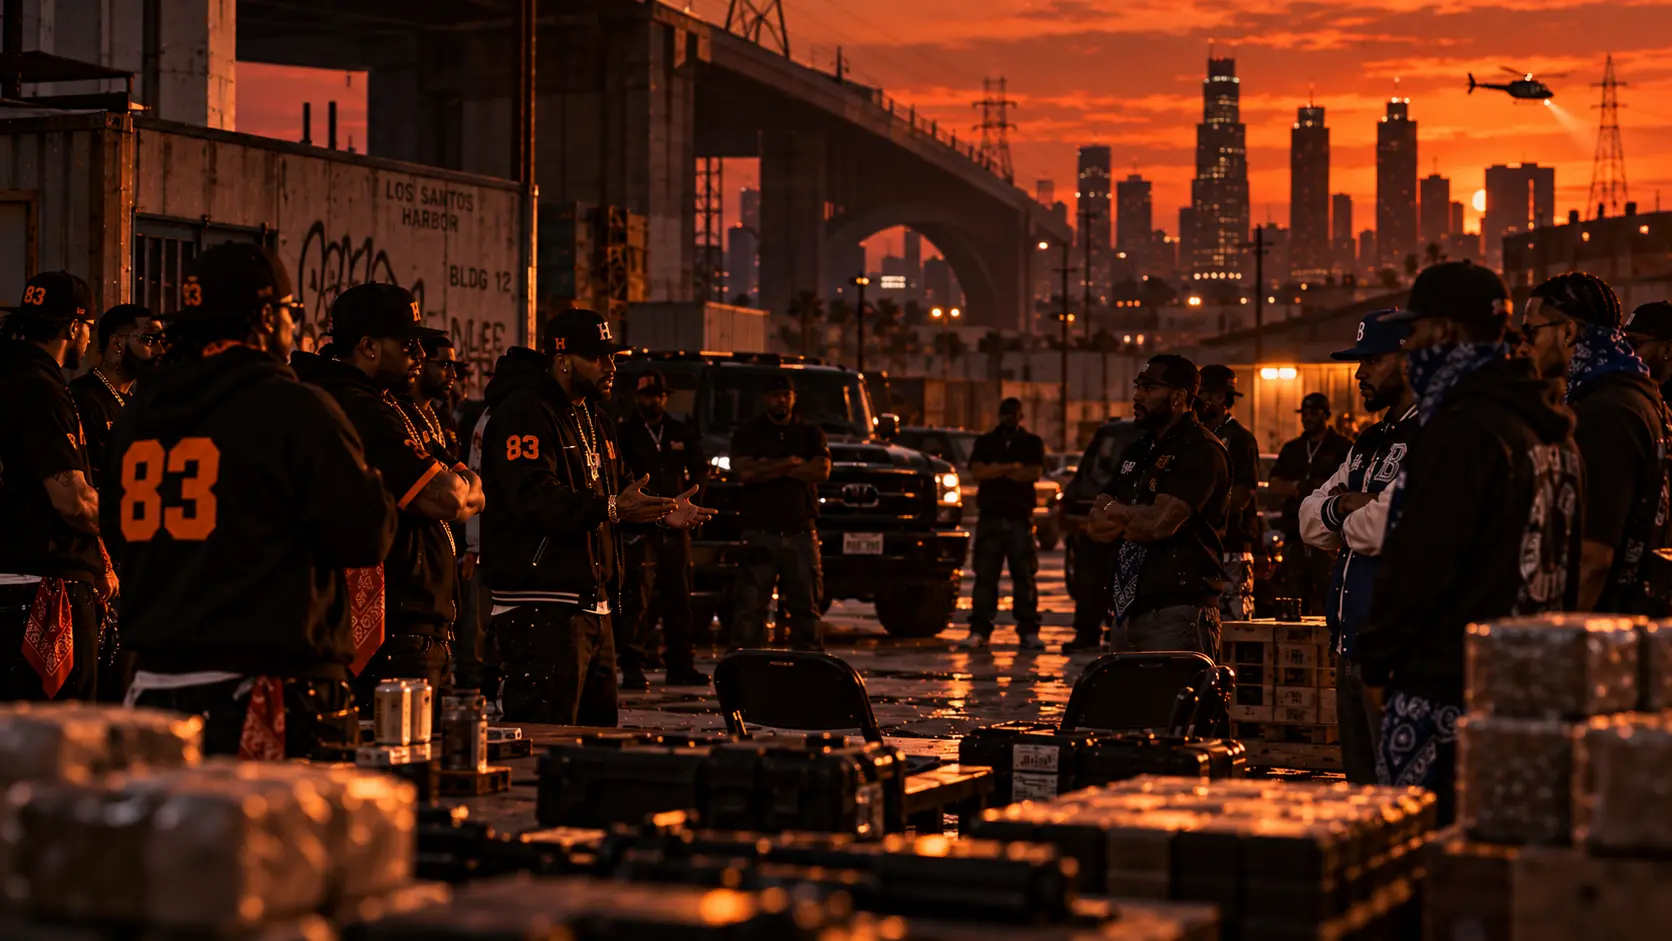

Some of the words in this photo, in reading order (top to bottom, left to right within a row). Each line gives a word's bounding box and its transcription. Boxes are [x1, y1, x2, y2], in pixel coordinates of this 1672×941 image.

[386, 180, 415, 202] LOS
[421, 186, 474, 212] SANTOS
[402, 207, 458, 232] HARBOR
[449, 265, 488, 290] BLDG
[495, 271, 511, 292] 12
[23, 284, 47, 306] 83
[554, 337, 567, 350] H
[596, 321, 613, 341] H
[1356, 321, 1366, 342] B
[506, 434, 540, 461] 83
[1373, 442, 1408, 483] B
[120, 436, 221, 543] 83
